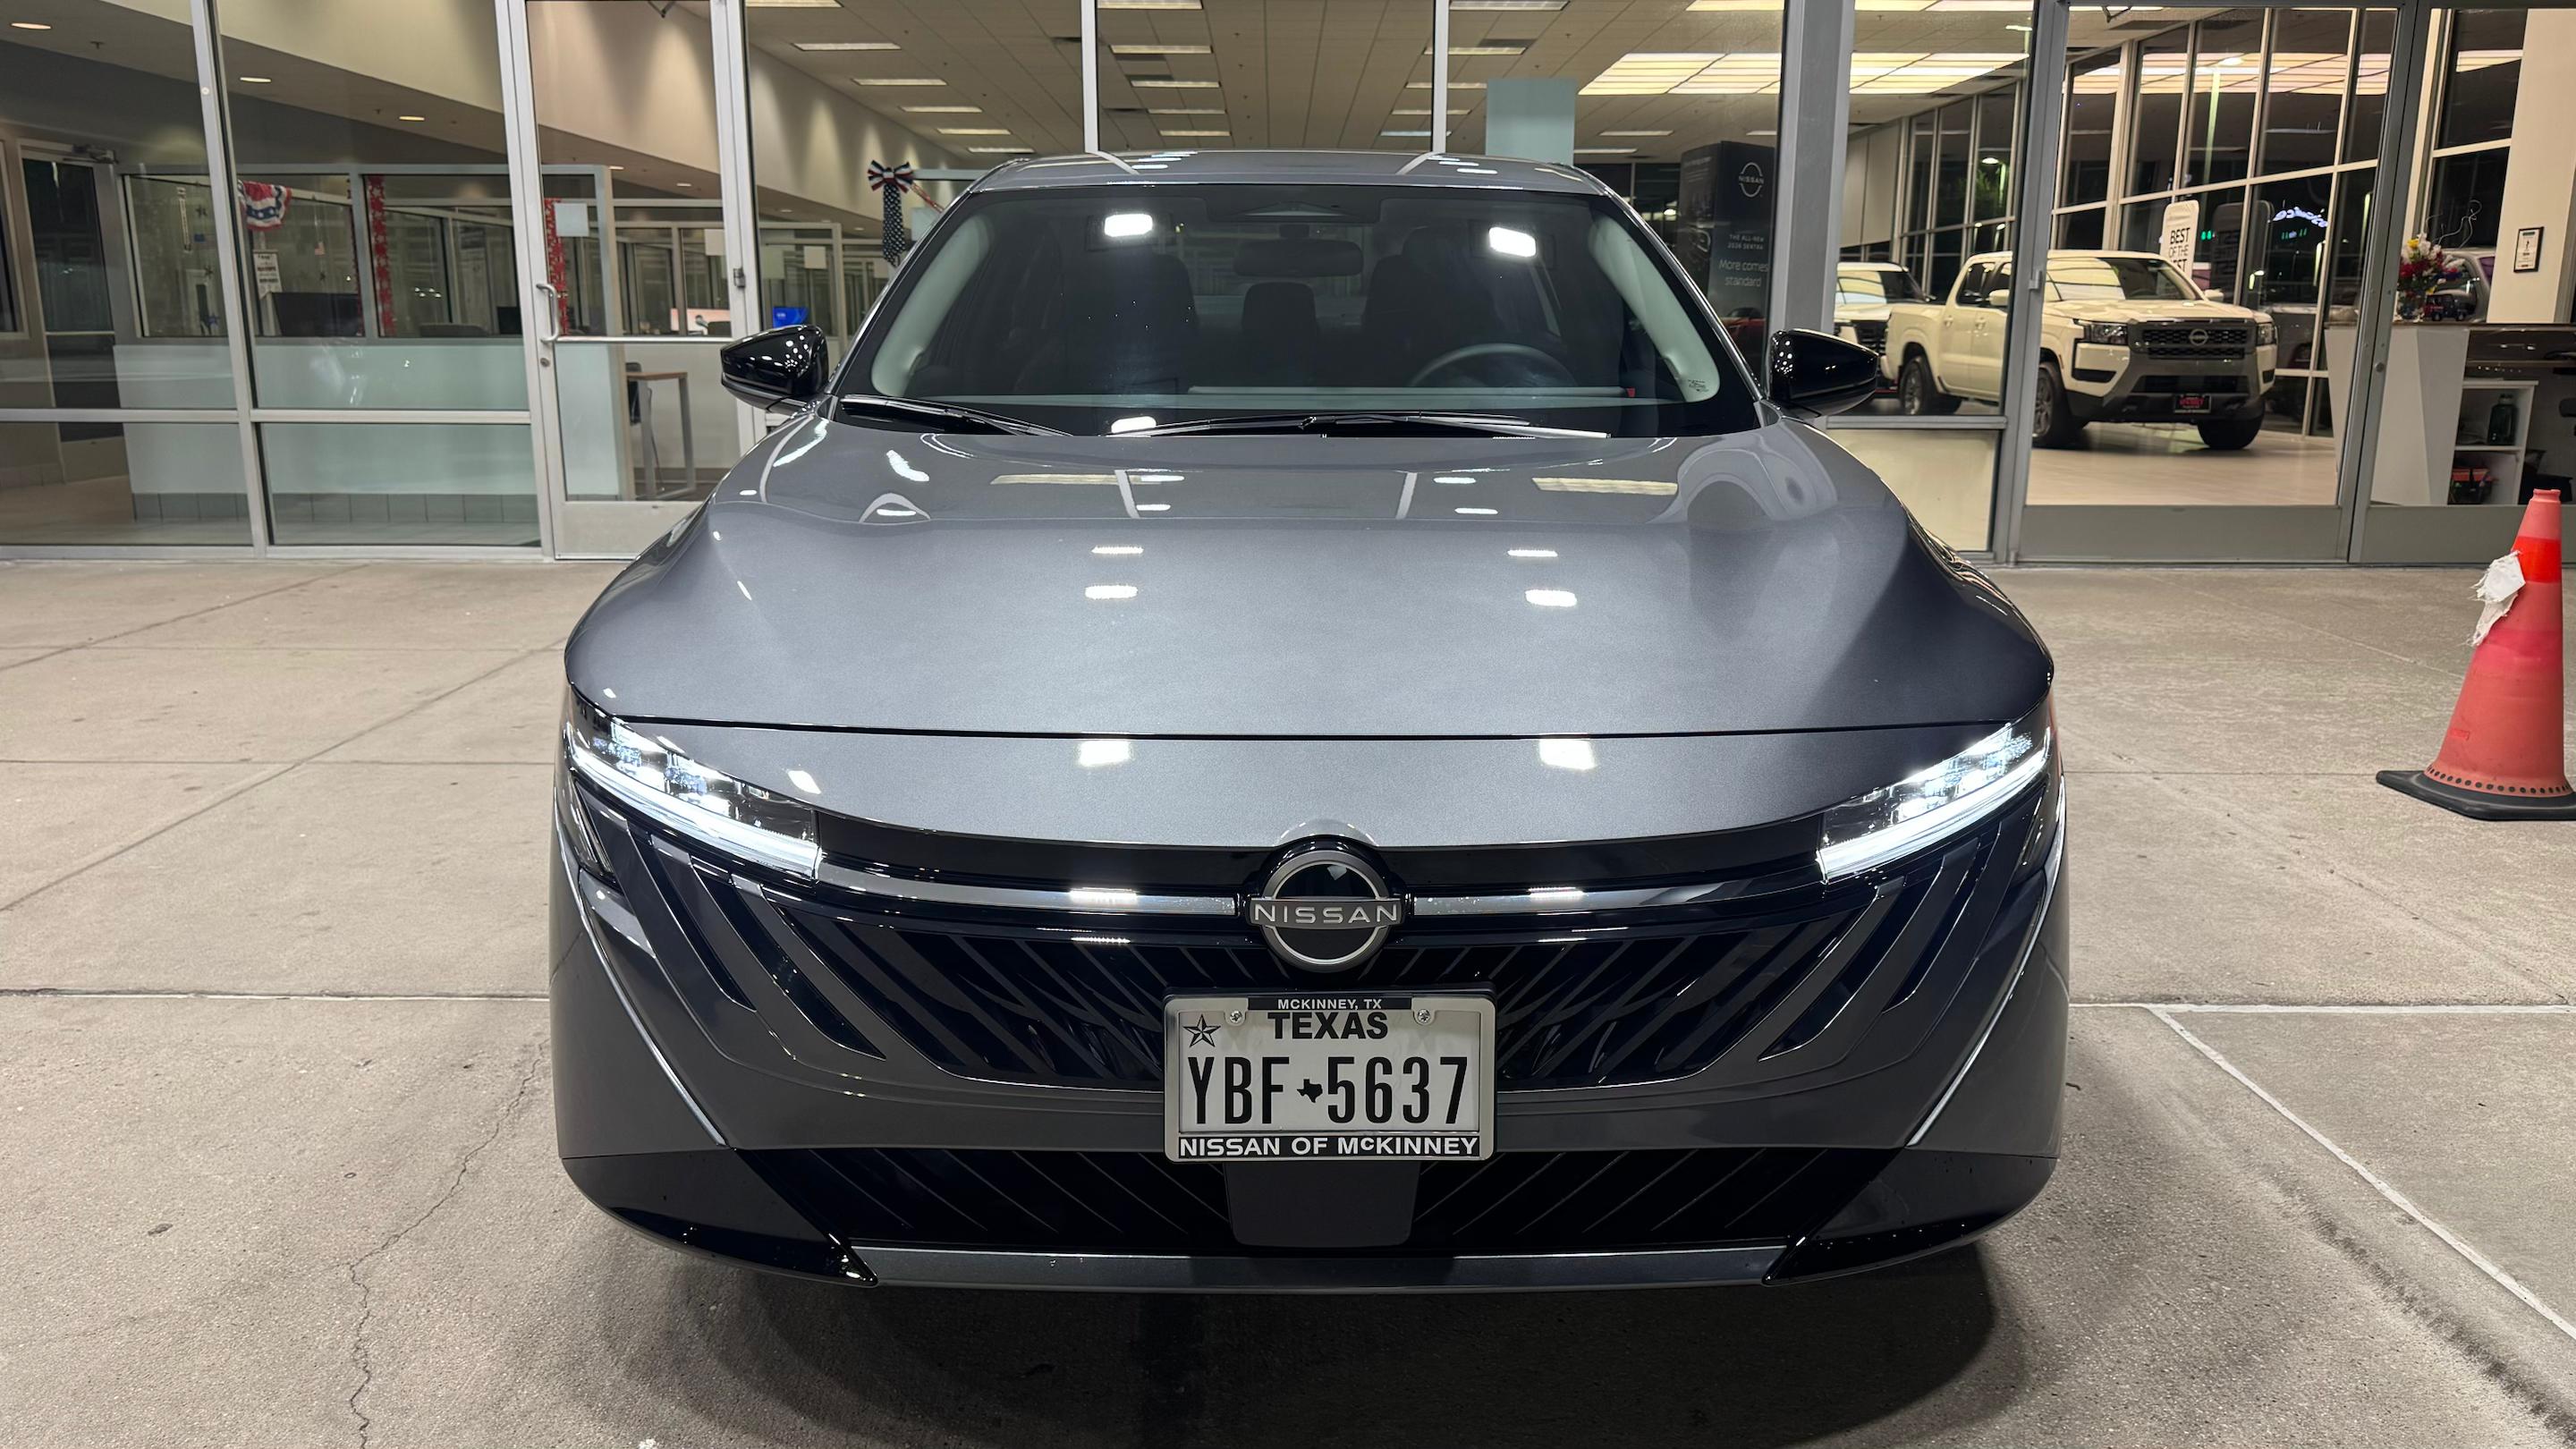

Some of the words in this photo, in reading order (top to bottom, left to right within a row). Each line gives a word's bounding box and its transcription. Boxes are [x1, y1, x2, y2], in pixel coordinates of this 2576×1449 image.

[2170, 227, 2190, 244] BEST
[2168, 246, 2176, 258] OF
[2177, 244, 2189, 258] THE
[1719, 259, 1741, 271] More
[1724, 275, 1761, 287] standard
[1254, 903, 1397, 925] NISSAN
[1277, 999, 1358, 1011] MCKINNEY,
[1364, 999, 1382, 1009] TX
[1267, 1012, 1388, 1039] TEXAS
[1188, 1056, 1290, 1124] YBF
[1327, 1056, 1468, 1124] 5637
[1180, 1138, 1280, 1156] NISSAN
[1292, 1138, 1328, 1155] OF
